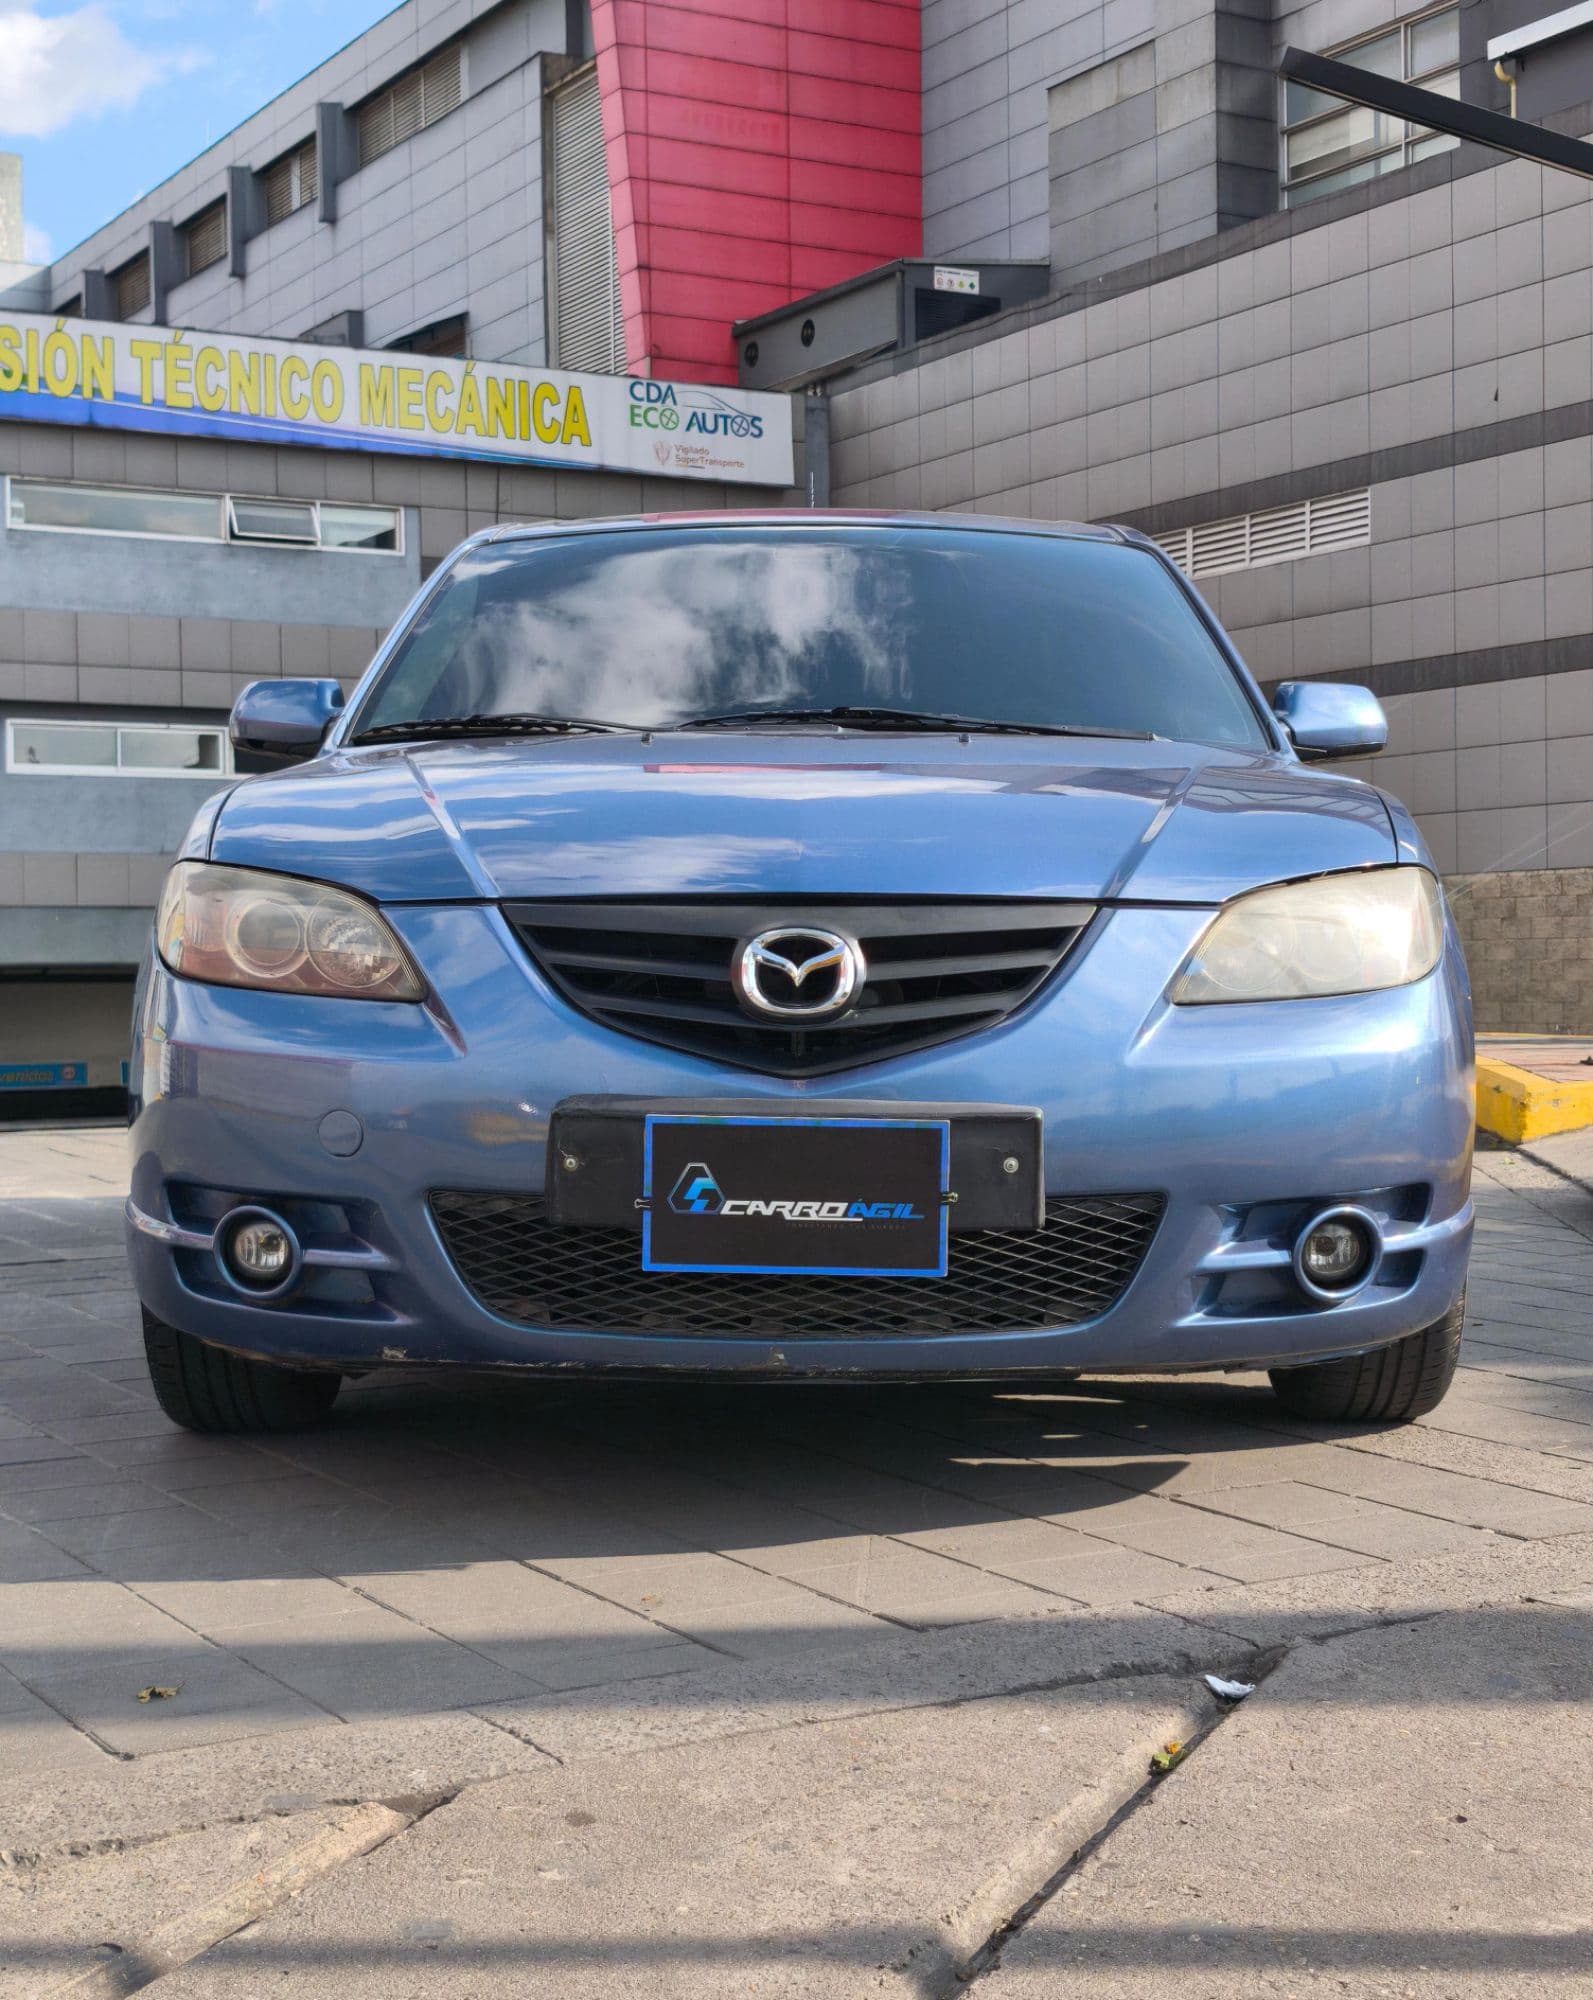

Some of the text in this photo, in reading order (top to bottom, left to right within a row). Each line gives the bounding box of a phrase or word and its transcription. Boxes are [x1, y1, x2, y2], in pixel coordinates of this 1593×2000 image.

[130, 328, 345, 424] TÉCNICO
[358, 359, 593, 447] MECÁNICA
[629, 381, 678, 406] CDA
[629, 404, 764, 439] ECO AUTOS
